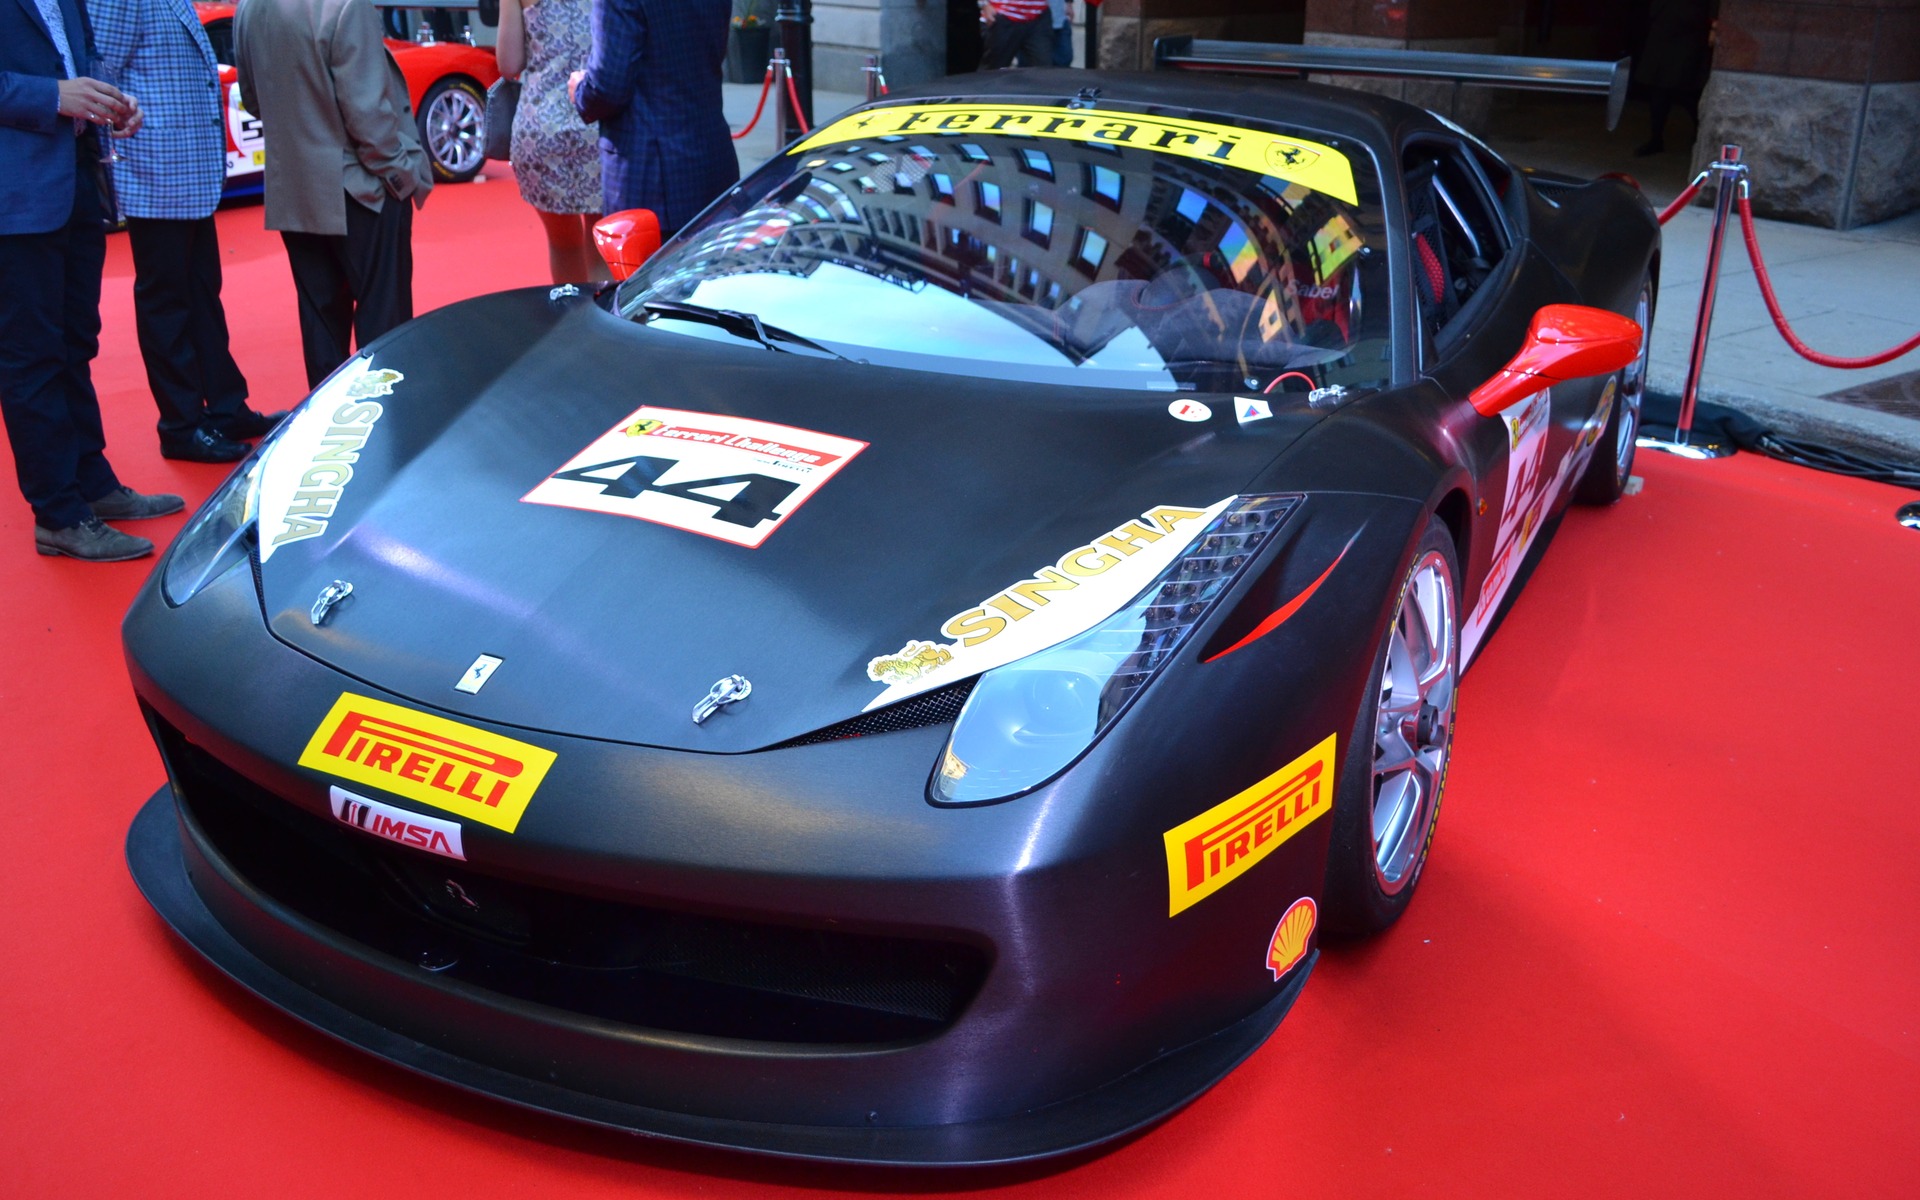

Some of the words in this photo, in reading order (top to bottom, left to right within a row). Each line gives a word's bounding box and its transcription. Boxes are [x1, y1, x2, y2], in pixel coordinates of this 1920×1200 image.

[888, 109, 1242, 160] Ferrari
[272, 402, 380, 546] SINGHA
[652, 423, 730, 444] Ferrari
[724, 434, 823, 463] Challenge
[550, 455, 801, 529] 44
[946, 508, 1207, 648] SINGHA
[322, 710, 524, 808] PIRELLI
[372, 813, 453, 854] IMSA
[1184, 759, 1324, 892] PIRELLI
